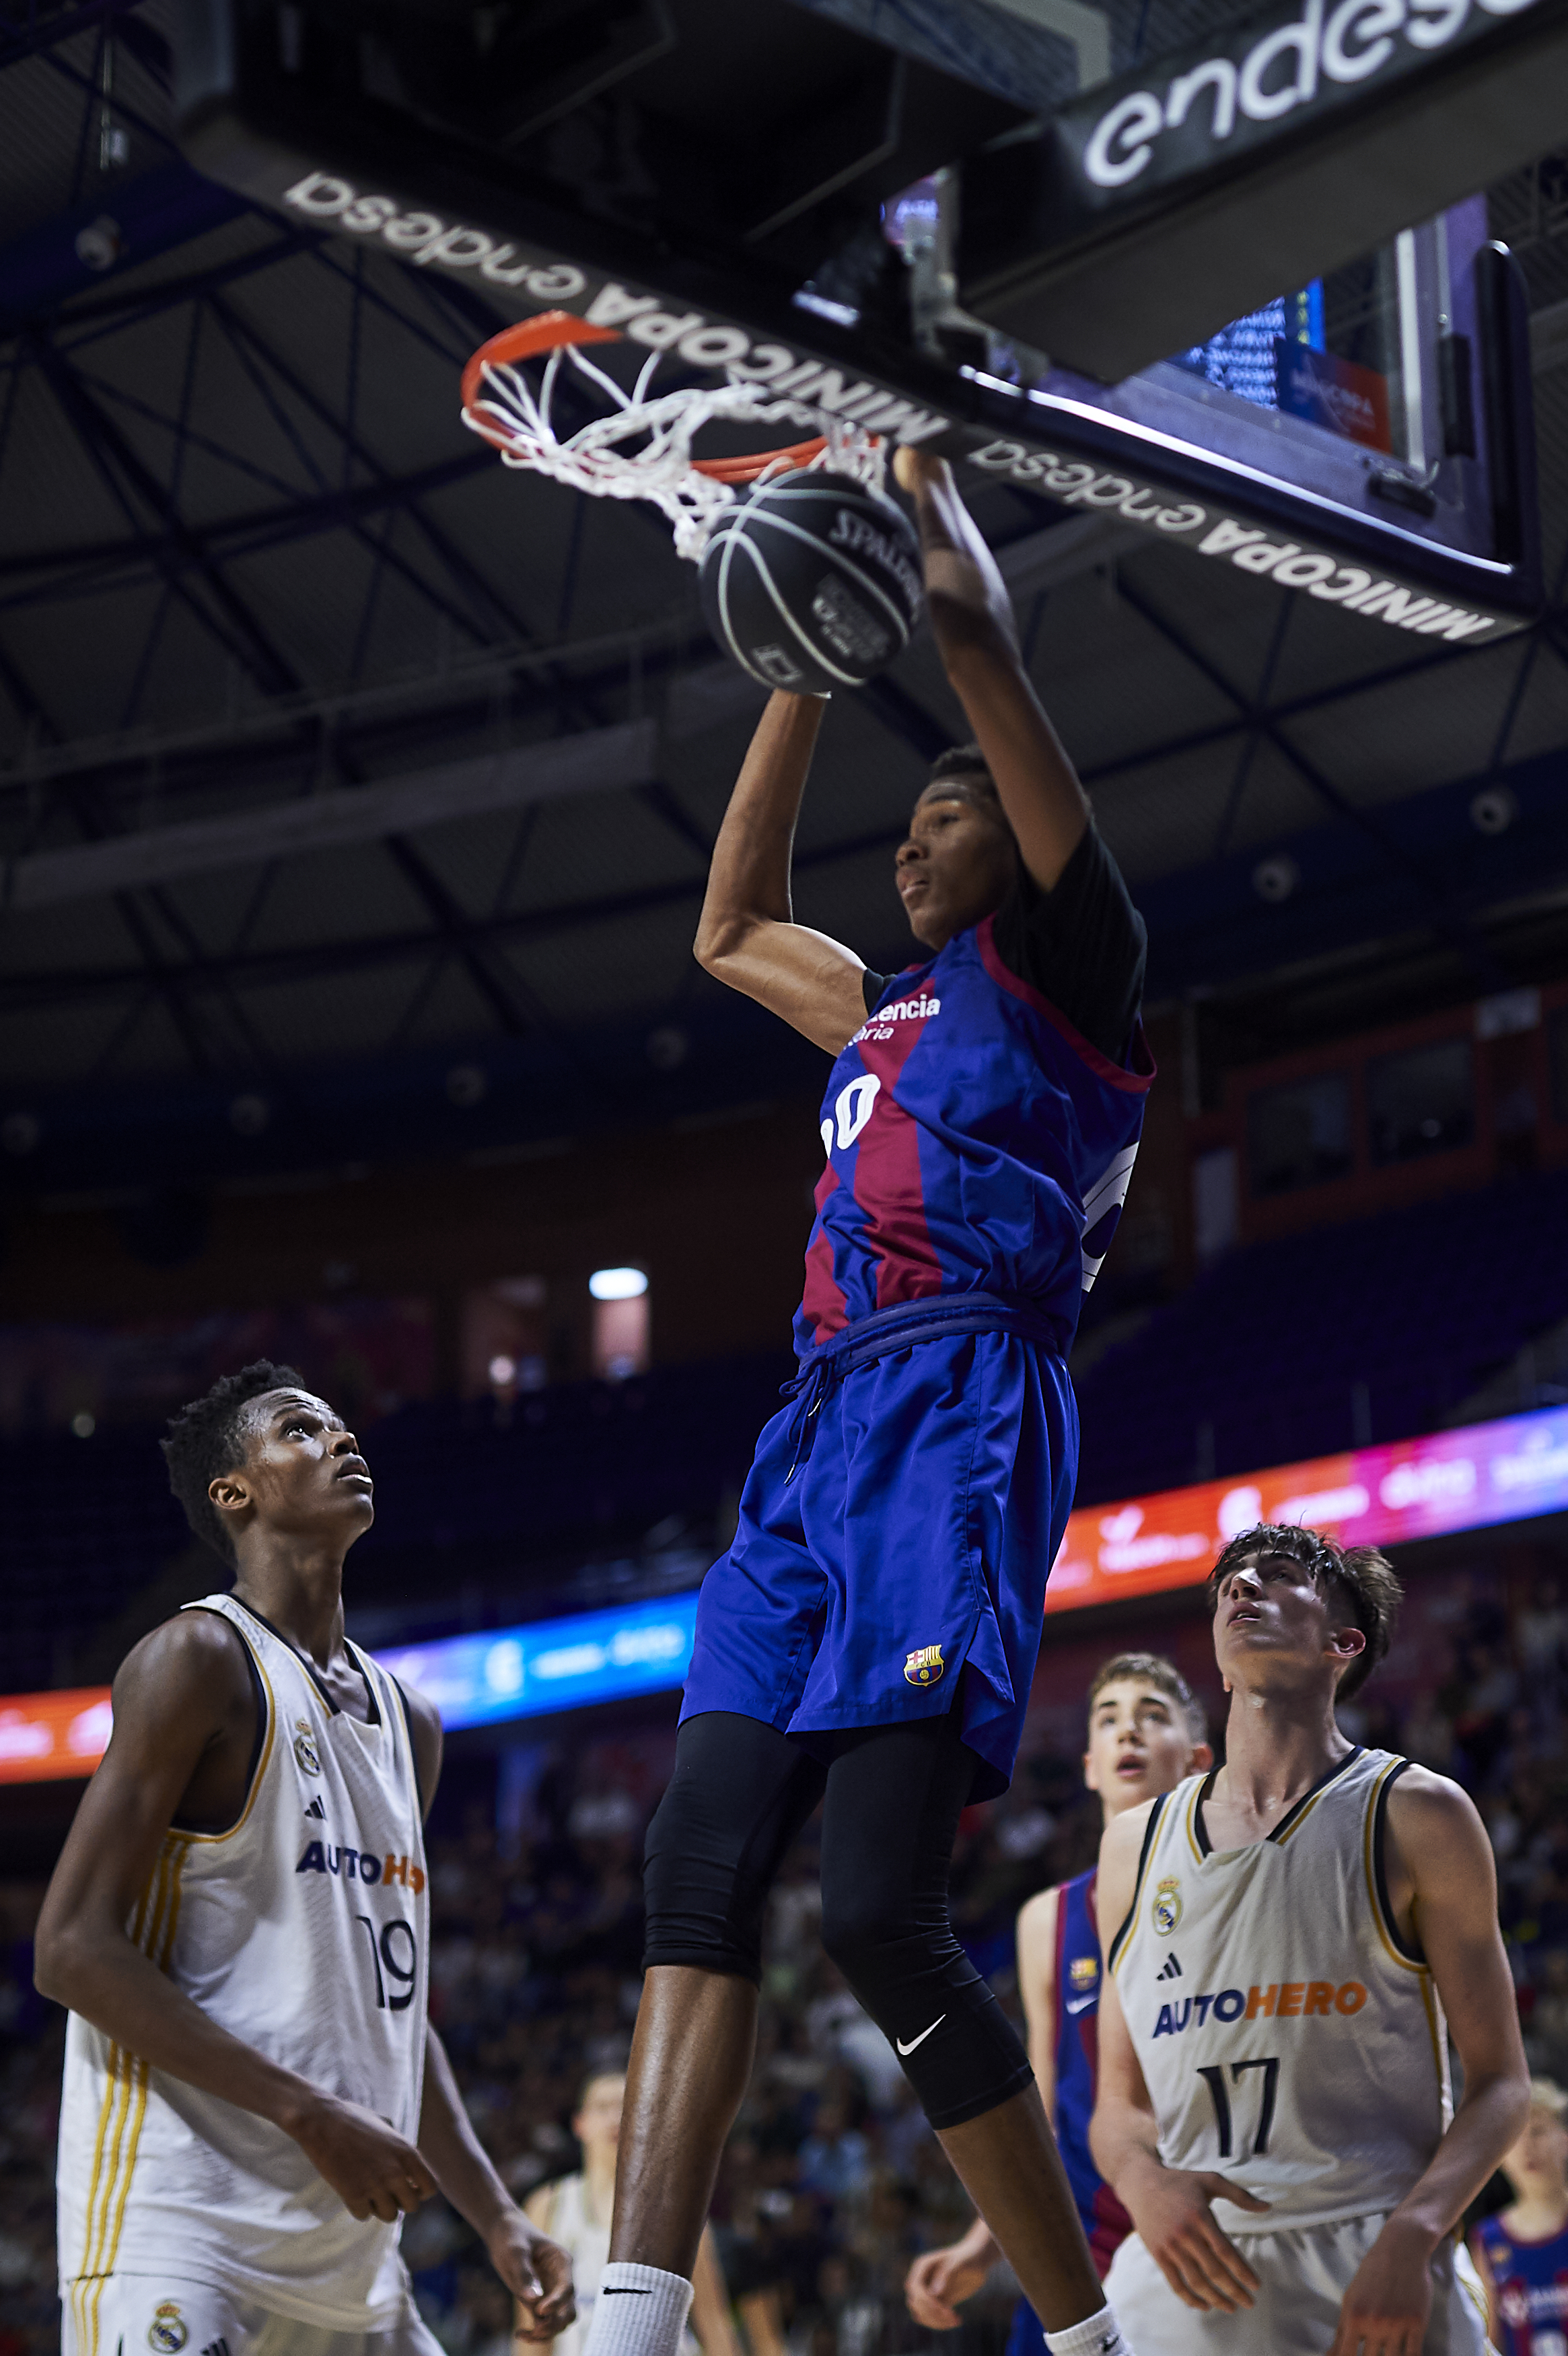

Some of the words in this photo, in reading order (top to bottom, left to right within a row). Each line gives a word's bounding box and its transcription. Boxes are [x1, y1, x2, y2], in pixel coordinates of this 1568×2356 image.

[283, 171, 587, 300] endesa
[585, 283, 950, 444] MINICOPA
[966, 439, 1207, 532] endesa
[1199, 518, 1496, 641] MINICOPA
[357, 1914, 417, 2011] 19
[1153, 1981, 1367, 2039] AUTOHERO
[1197, 2057, 1279, 2158] 17
